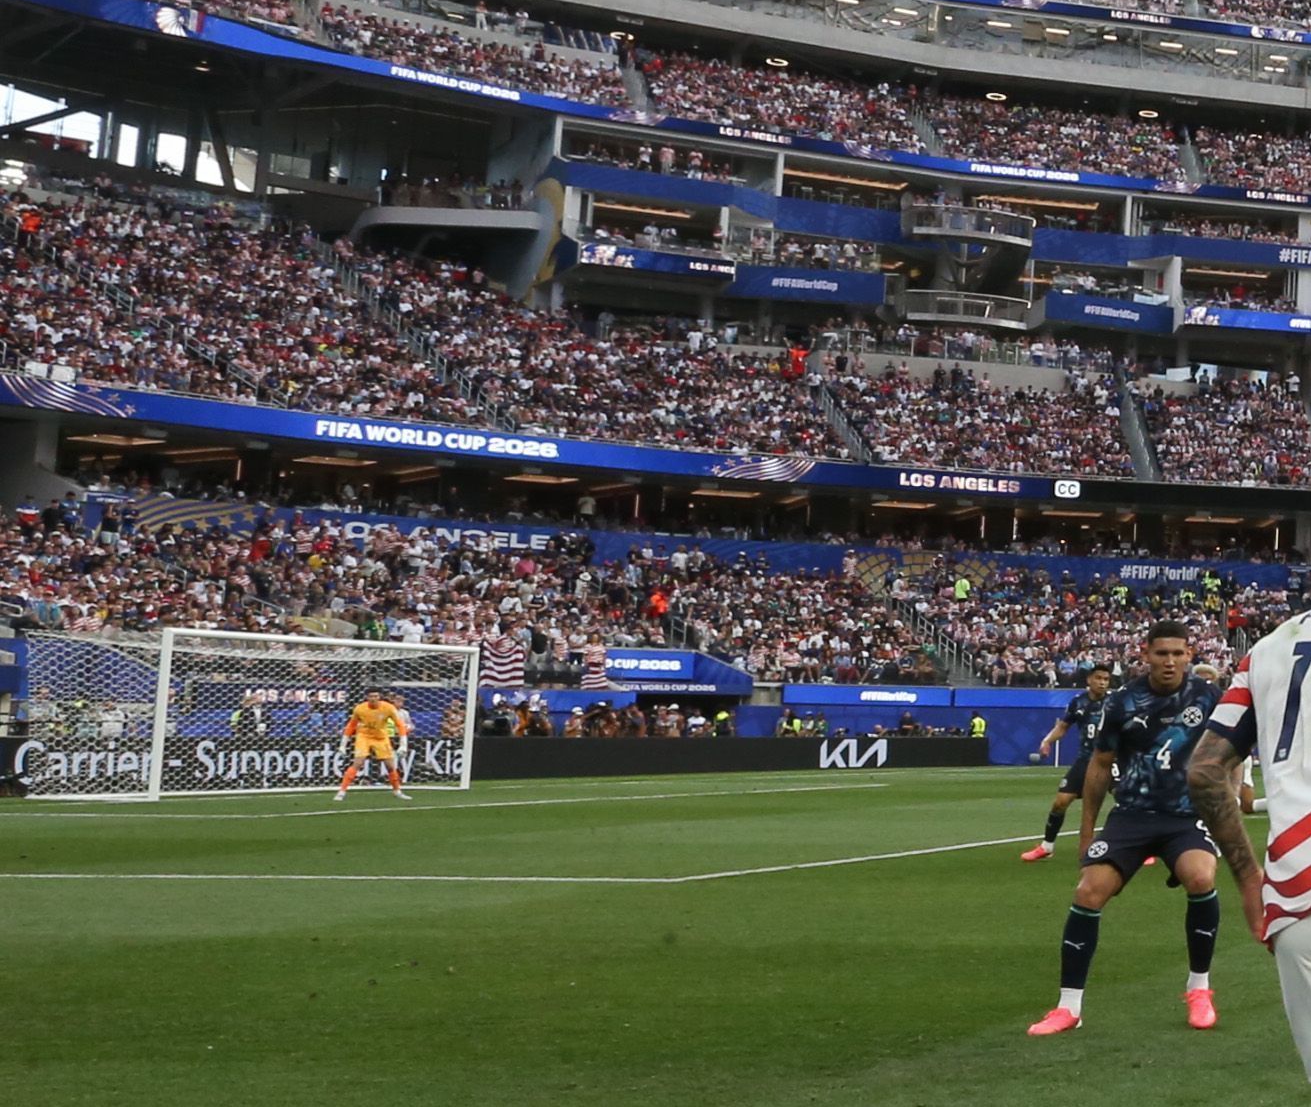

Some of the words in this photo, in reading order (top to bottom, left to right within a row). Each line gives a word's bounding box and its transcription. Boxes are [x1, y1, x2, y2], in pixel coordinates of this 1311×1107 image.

[391, 66, 416, 80] FIFA
[418, 72, 457, 88] WORLD
[459, 80, 482, 93] CUP
[971, 164, 989, 174] FIFA
[991, 166, 1025, 178] WORLD
[1026, 169, 1045, 180] CUP
[772, 276, 838, 292] #FIFAWorldCup
[316, 420, 362, 441] FIFA
[366, 425, 441, 447] WORLD
[445, 432, 486, 452] CUP
[488, 438, 558, 458] 2026
[900, 472, 936, 489] LOS
[940, 476, 1020, 494] ANGELES
[1058, 483, 1077, 496] CC
[614, 658, 638, 669] CUP
[639, 659, 681, 671] 2026
[1157, 739, 1172, 769] 4
